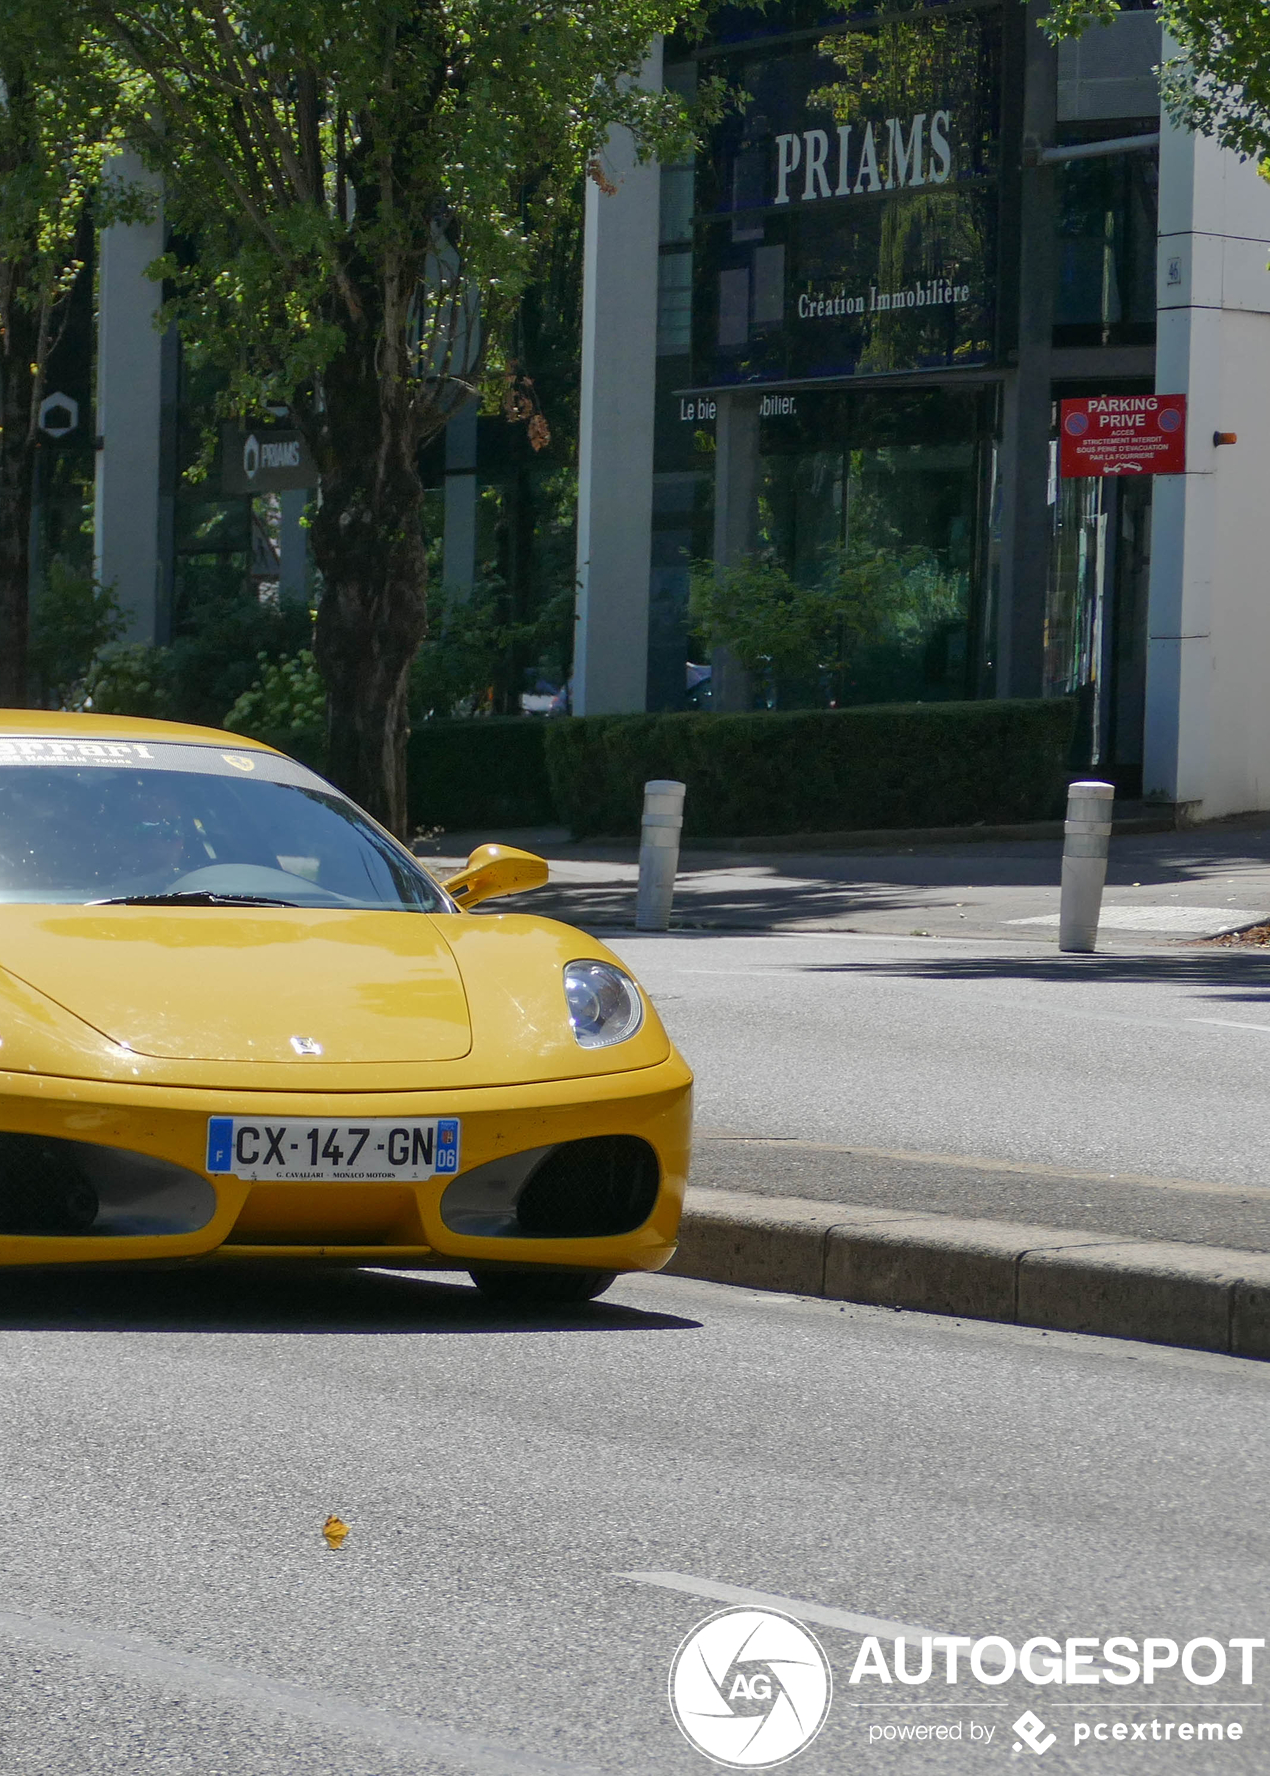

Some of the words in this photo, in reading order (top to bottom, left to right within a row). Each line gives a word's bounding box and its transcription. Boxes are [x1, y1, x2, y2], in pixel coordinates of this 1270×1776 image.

[774, 110, 951, 205] PRIAMS
[798, 289, 865, 319] Création
[869, 278, 970, 312] Immobilière
[680, 398, 695, 421] Le
[697, 398, 717, 420] bie
[1088, 398, 1158, 412] PARKING
[1100, 414, 1146, 427] PRIVE
[1083, 437, 1130, 445] STRICTEMENT
[1119, 444, 1168, 452] D'EVACUATION
[261, 440, 300, 468] PRIAMS
[235, 1126, 434, 1166] CX-147-GN
[216, 1150, 224, 1162] F
[437, 1149, 456, 1167] 06
